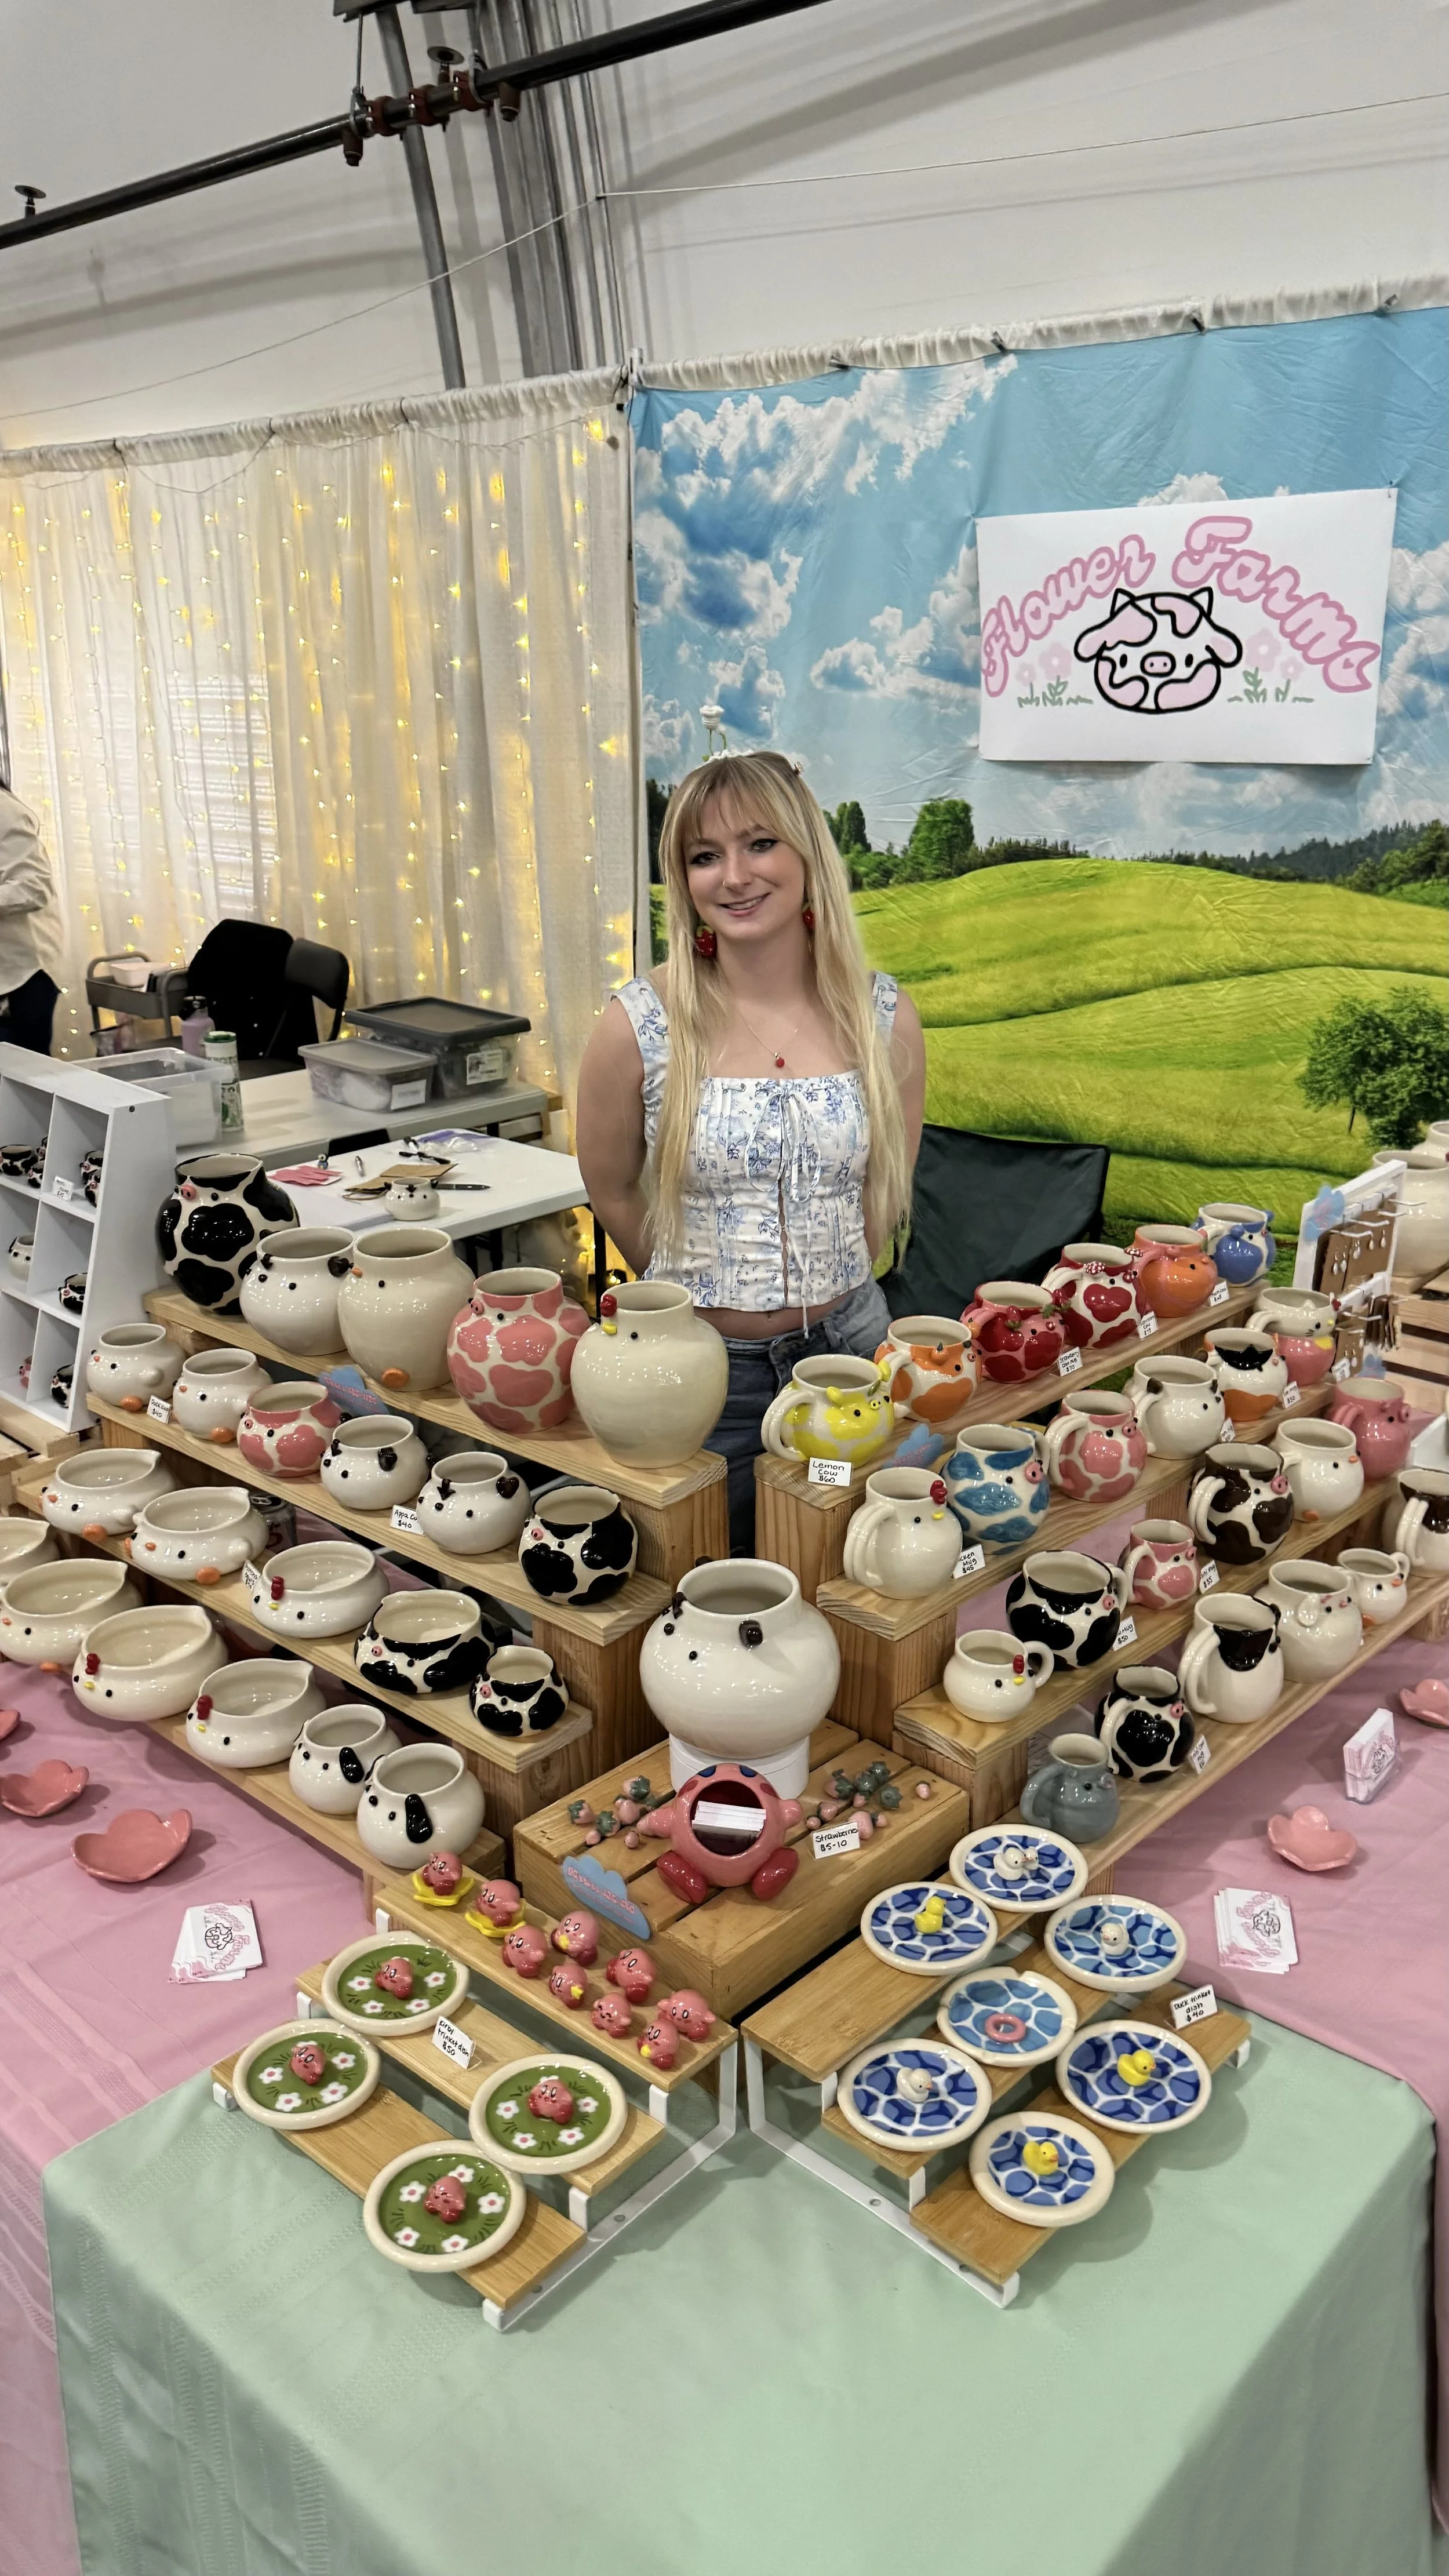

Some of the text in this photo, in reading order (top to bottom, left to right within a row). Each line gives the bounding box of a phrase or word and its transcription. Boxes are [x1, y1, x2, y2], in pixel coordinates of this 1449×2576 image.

[981, 533, 1156, 698] Flower
[813, 1460, 844, 1471] Lemon
[818, 1475, 836, 1483] $60
[398, 1519, 412, 1529] $40
[1117, 1635, 1128, 1644] $50
[820, 1839, 847, 1852] $5-10
[1186, 2010, 1204, 2022] $40
[442, 2040, 456, 2055] $50
